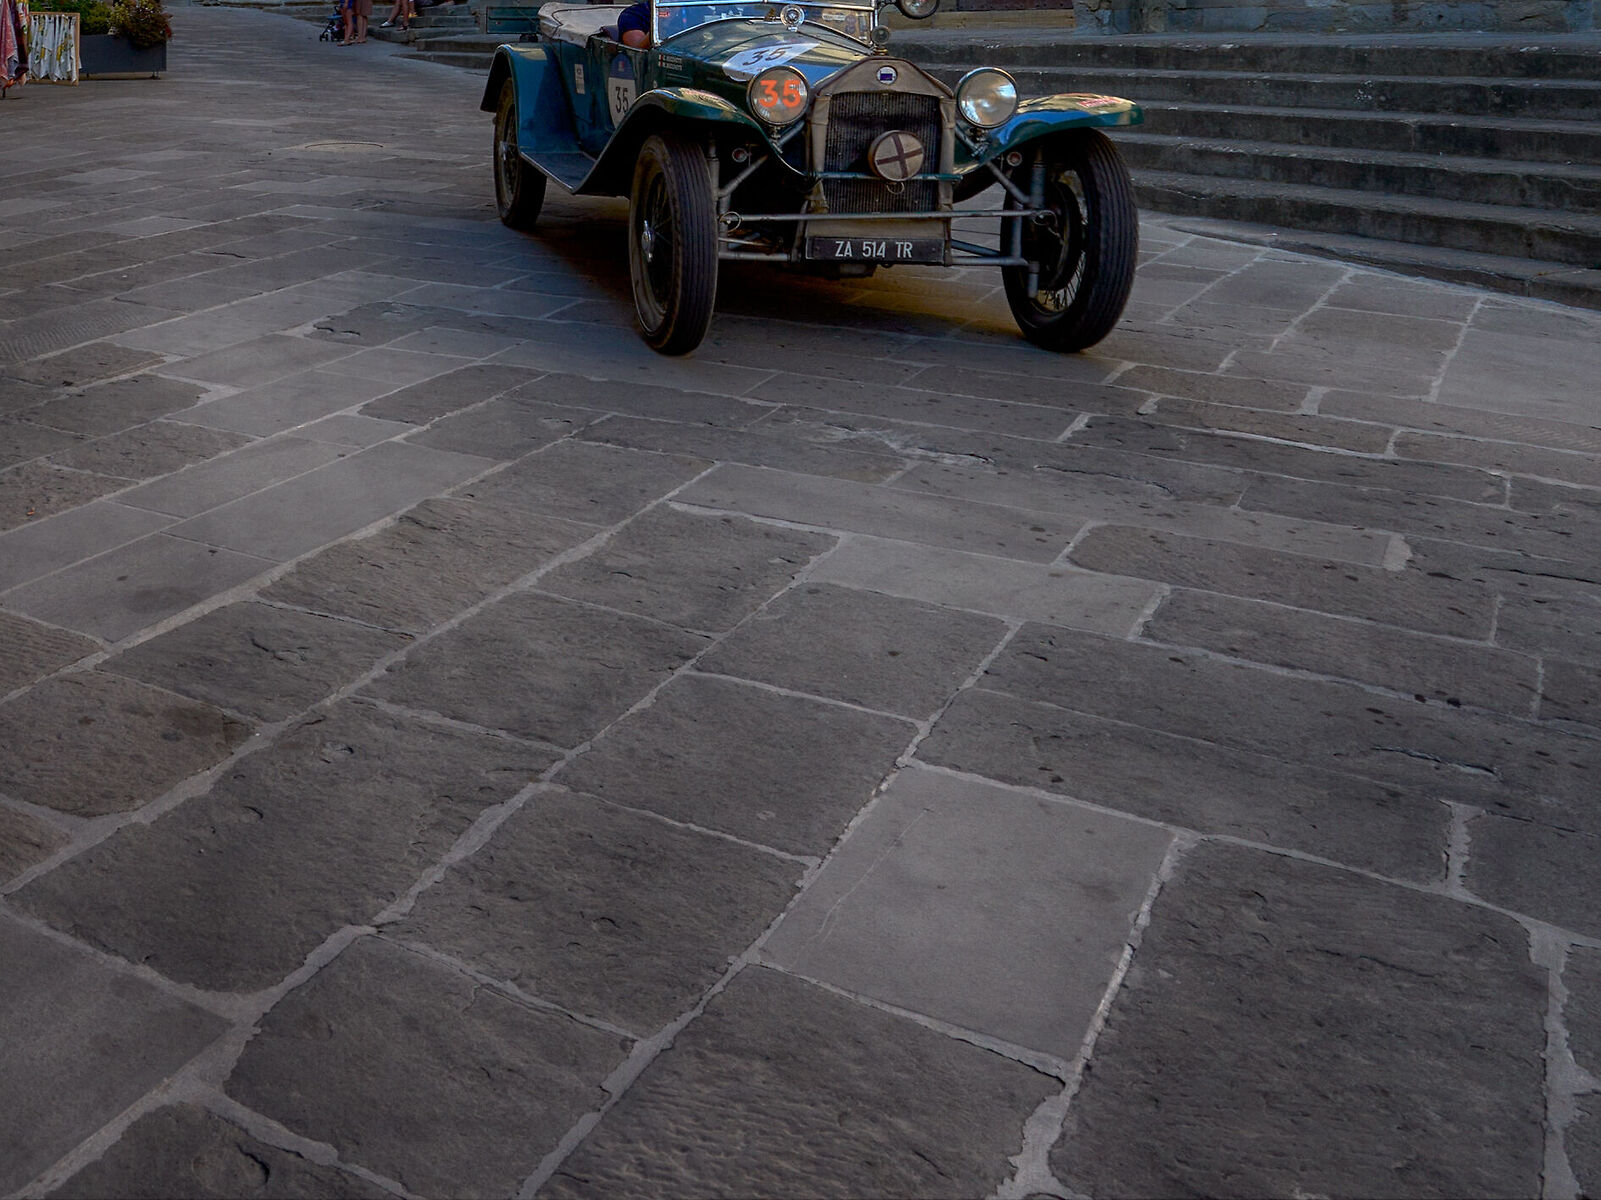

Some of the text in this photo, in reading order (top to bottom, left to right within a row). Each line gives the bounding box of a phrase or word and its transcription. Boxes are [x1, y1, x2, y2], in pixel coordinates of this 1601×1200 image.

[742, 46, 793, 66] 35
[615, 86, 629, 113] 35
[759, 80, 802, 108] 35
[835, 241, 913, 258] ZA 514 TR
